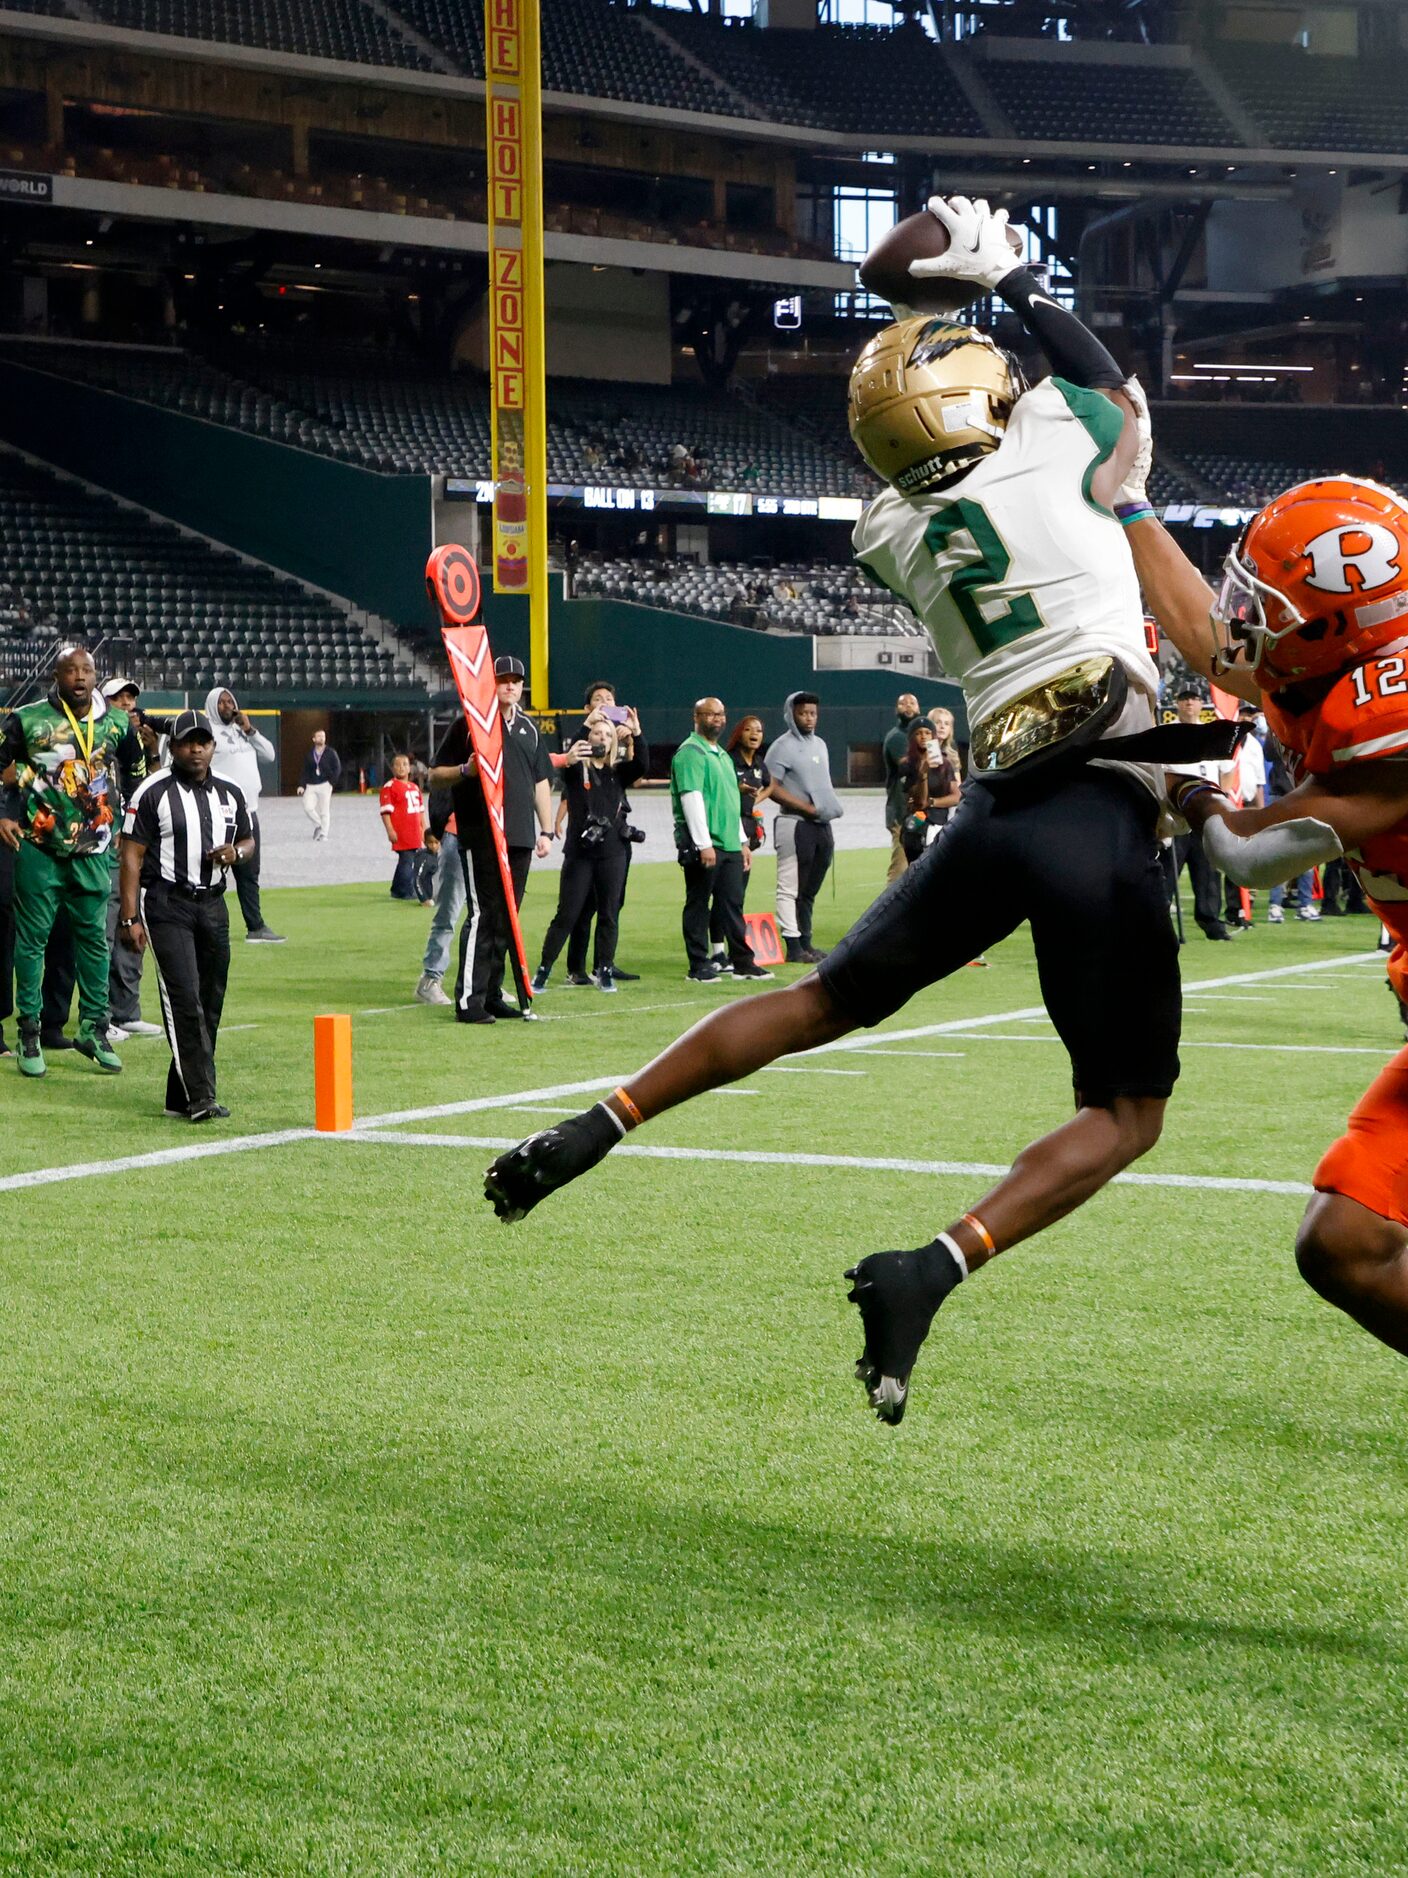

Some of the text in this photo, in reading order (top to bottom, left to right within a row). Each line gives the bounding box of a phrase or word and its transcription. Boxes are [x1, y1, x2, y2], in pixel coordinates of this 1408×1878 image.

[497, 104, 517, 216] HOT
[499, 253, 520, 406] ZONE
[476, 481, 495, 502] 2N
[898, 456, 943, 488] schutt
[923, 497, 1050, 658] 2
[1302, 523, 1402, 594] R
[405, 790, 421, 814] 15
